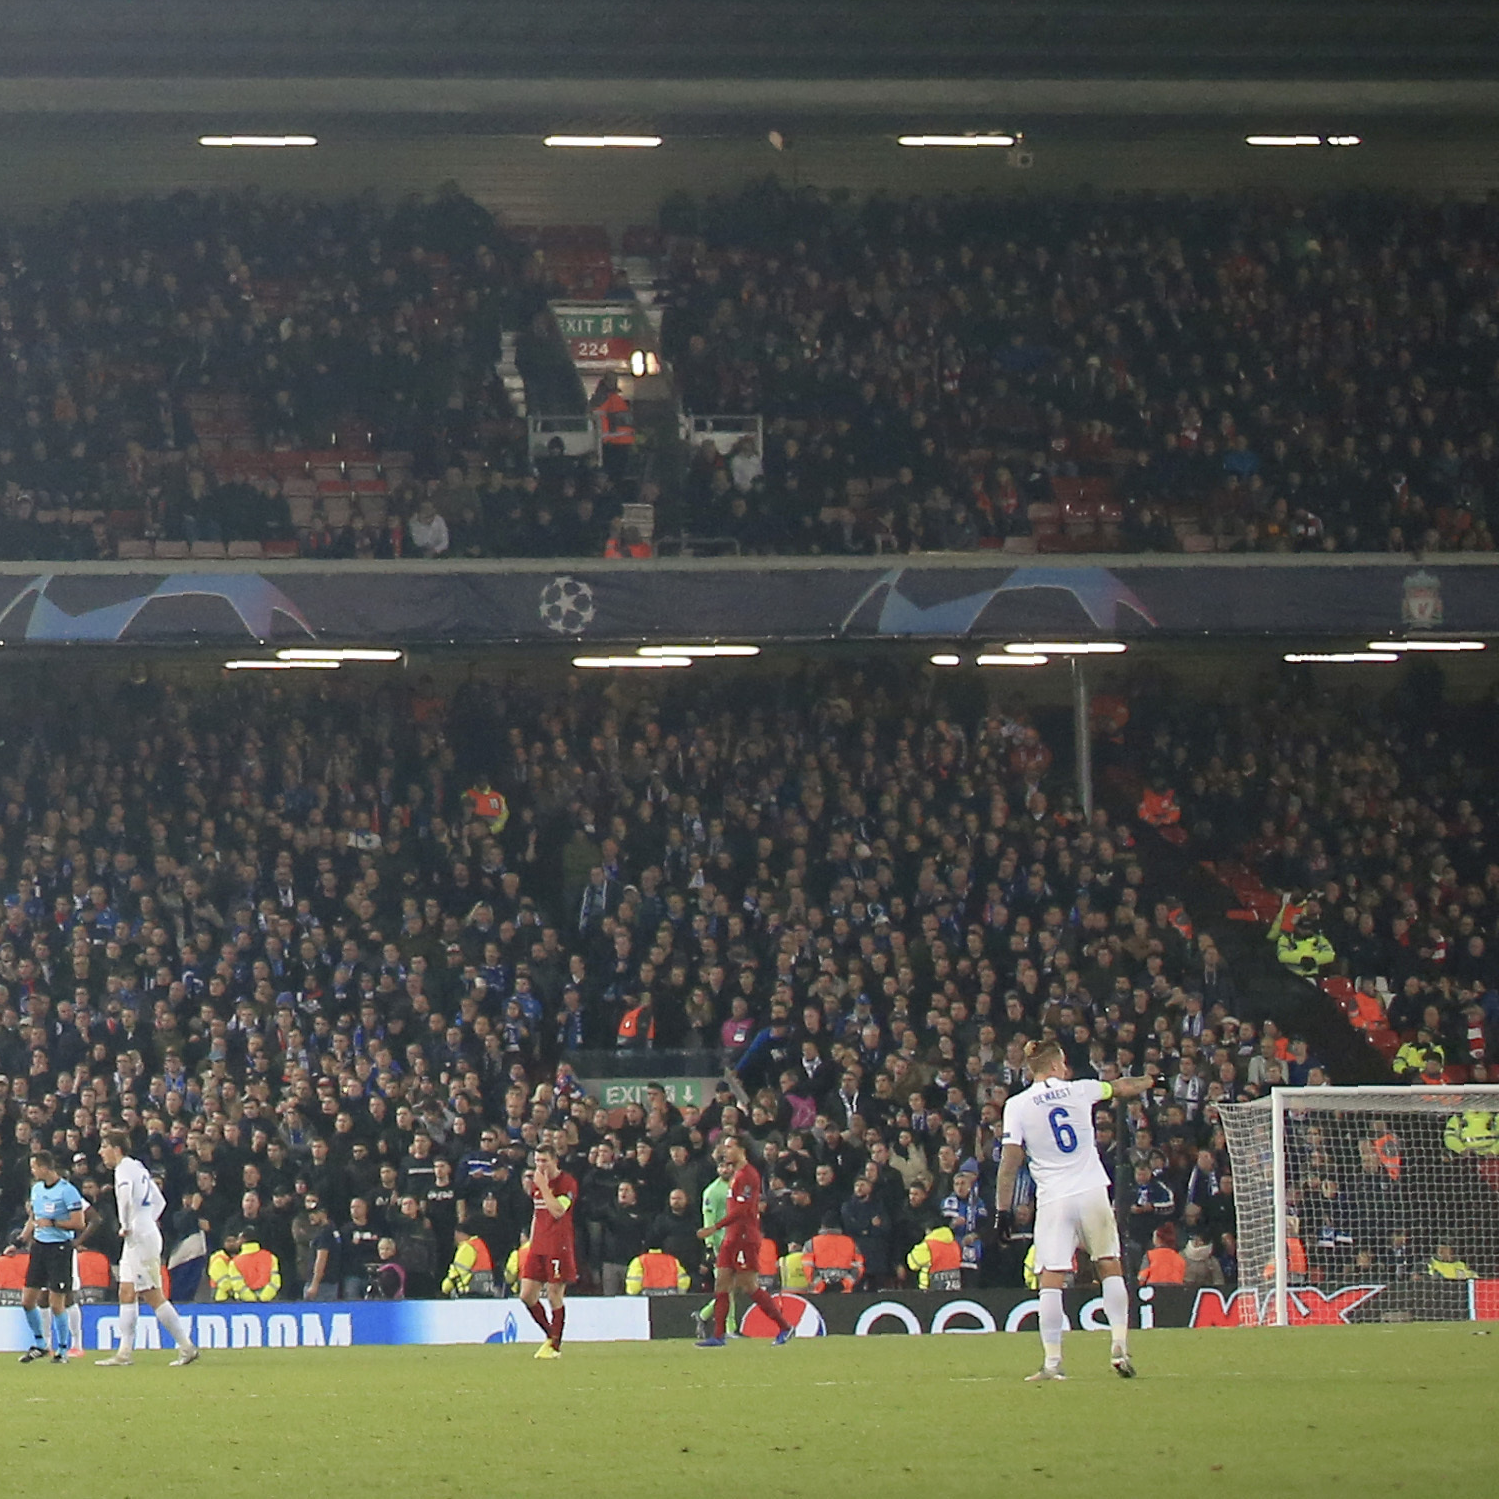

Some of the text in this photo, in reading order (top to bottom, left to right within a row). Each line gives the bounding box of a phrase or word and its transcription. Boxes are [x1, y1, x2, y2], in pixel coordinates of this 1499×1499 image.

[578, 342, 609, 356] 224
[1048, 1107, 1078, 1153] 6
[736, 1250, 745, 1264] 4
[551, 1258, 561, 1274] 7
